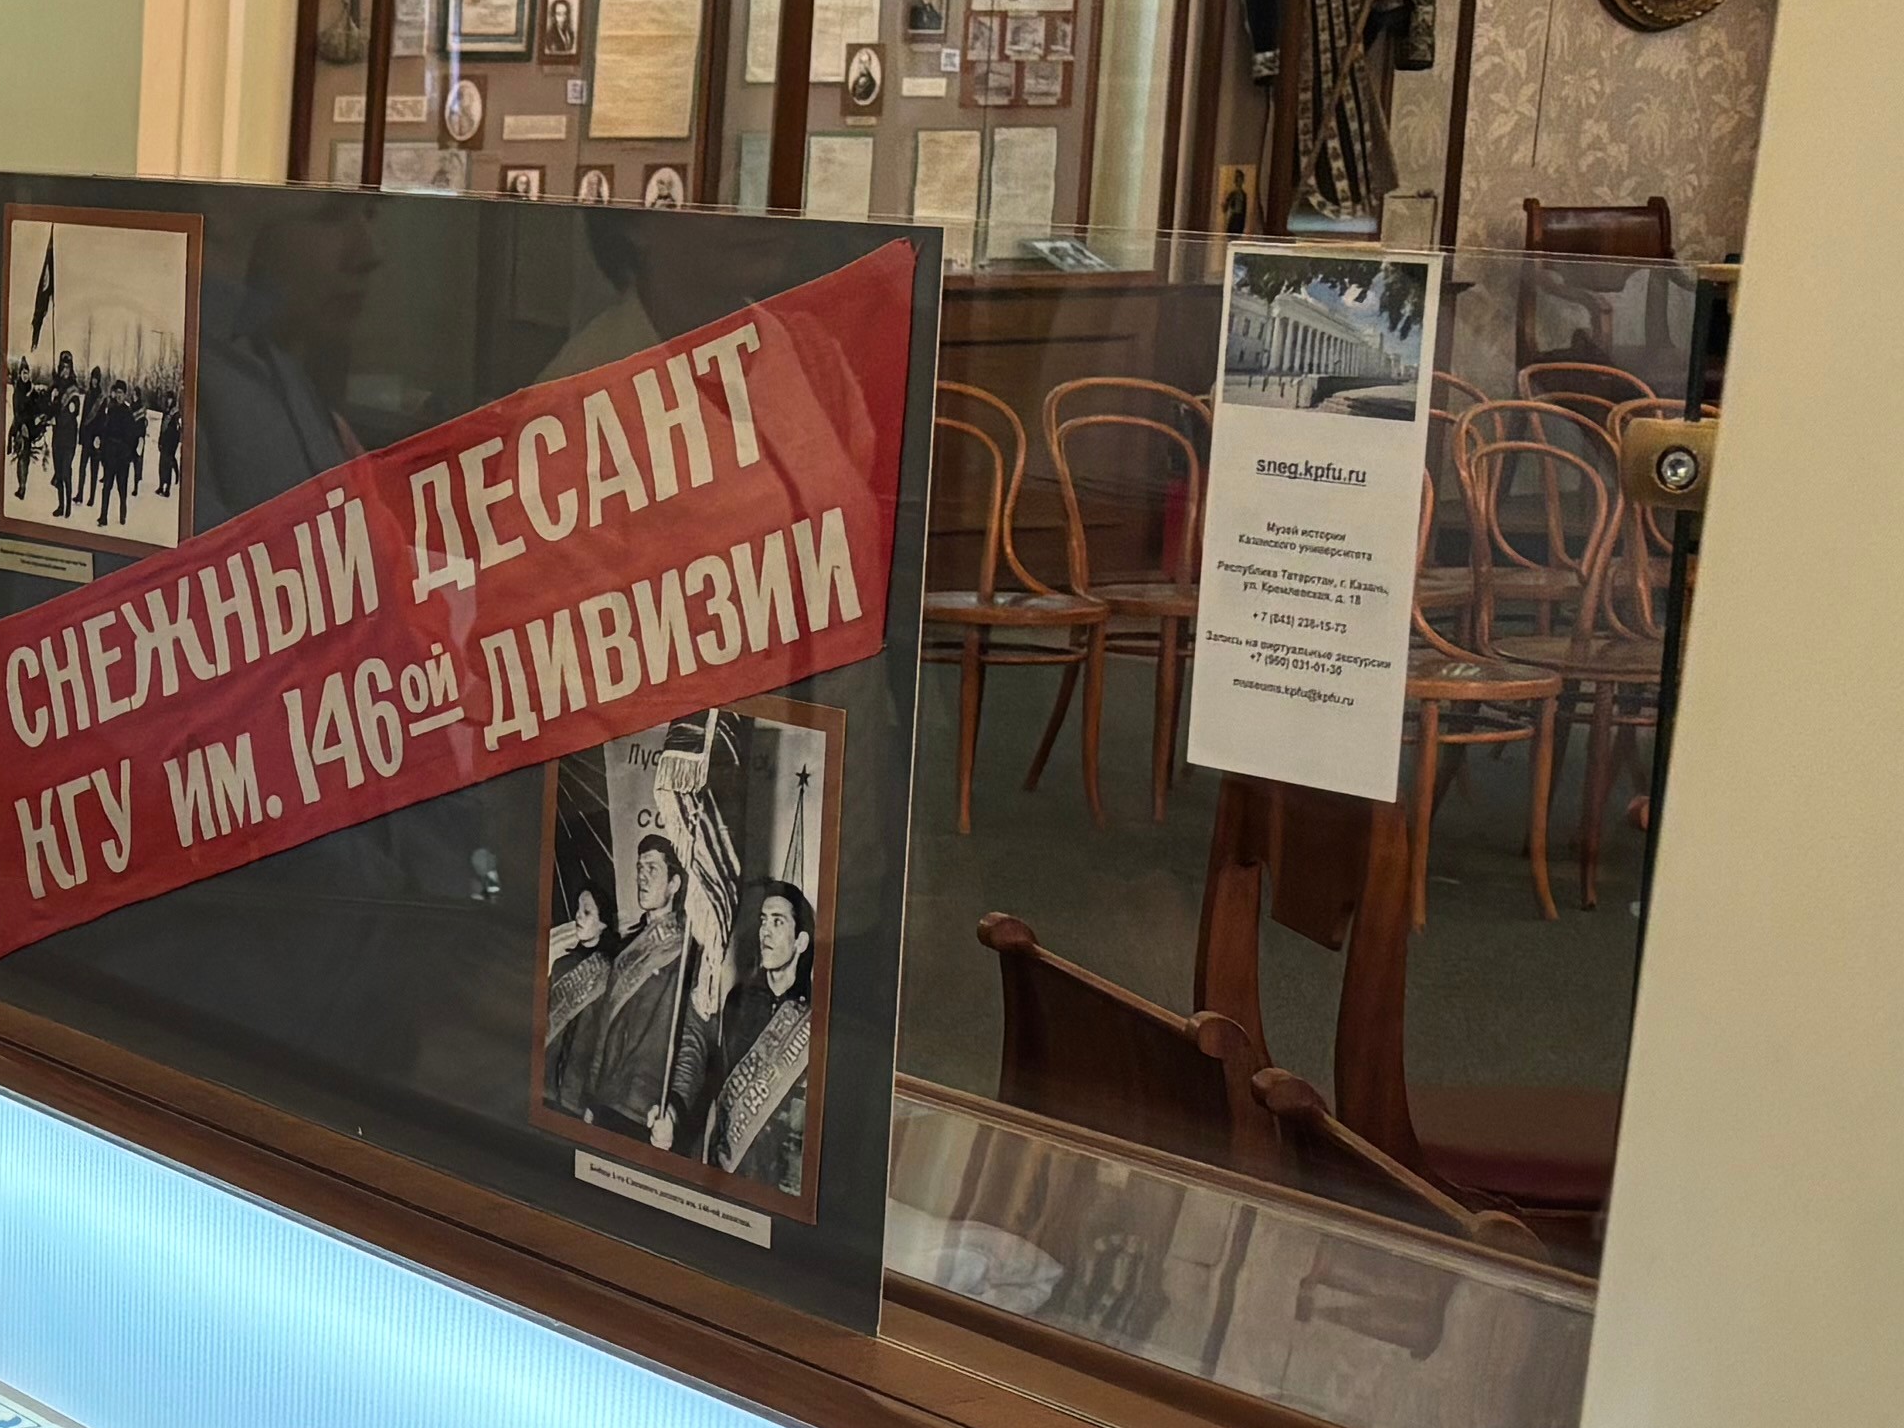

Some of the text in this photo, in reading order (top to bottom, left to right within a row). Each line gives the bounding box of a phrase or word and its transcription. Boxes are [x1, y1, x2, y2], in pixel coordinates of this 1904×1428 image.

[7, 323, 764, 748] СНЕЖНЫЙ ДЕСАНТ
[1255, 458, 1367, 486] sneg.kpfu.ru
[1267, 522, 1298, 535] Музей
[14, 759, 134, 900] КГУ
[481, 507, 864, 752] ДИВИЗИИ
